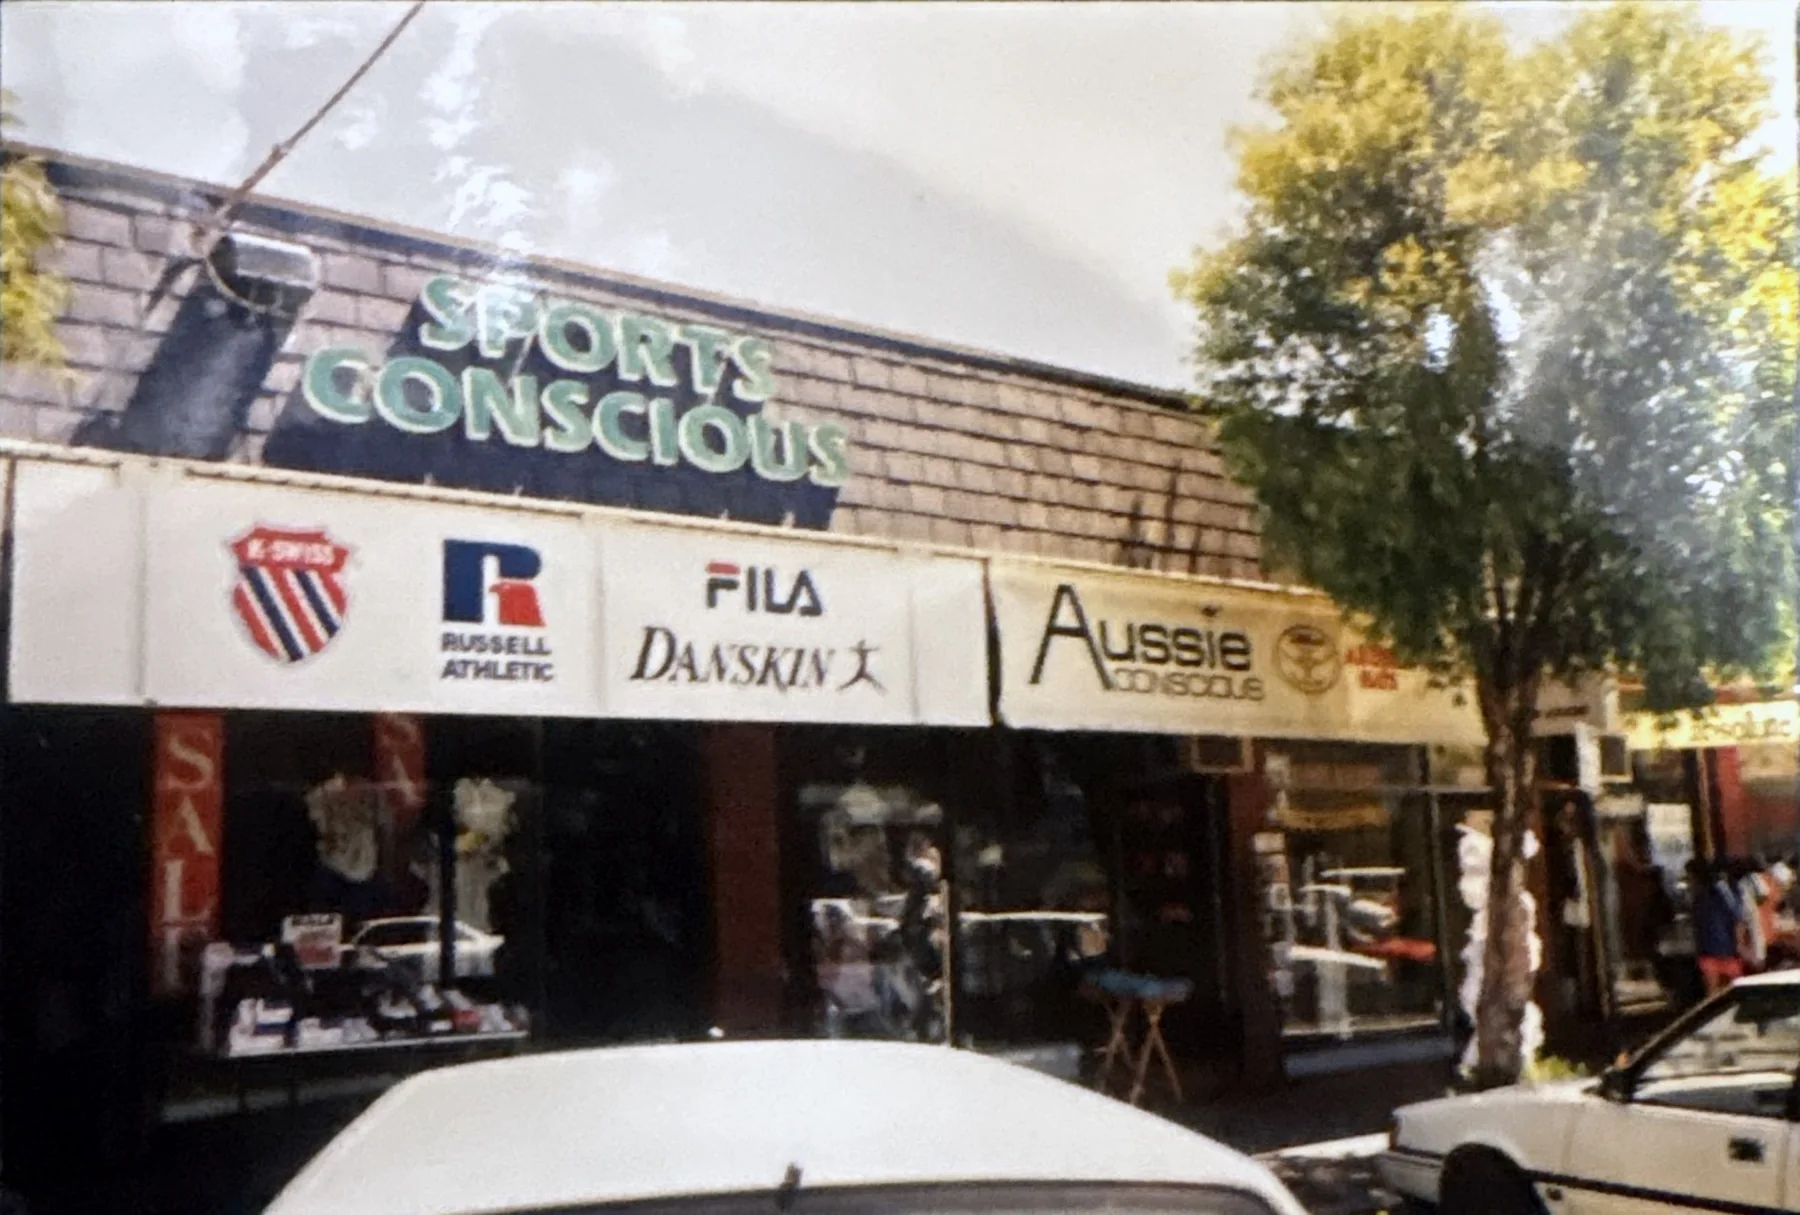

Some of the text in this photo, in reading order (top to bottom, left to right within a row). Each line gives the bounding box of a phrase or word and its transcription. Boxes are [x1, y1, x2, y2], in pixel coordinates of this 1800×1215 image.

[420, 275, 776, 402] SPORTS
[302, 345, 849, 487] CONSCIOUS
[705, 561, 824, 616] FILA
[440, 660, 554, 681] ATHLETIC
[441, 632, 552, 655] RUSSELL
[630, 625, 836, 693] DANSKIN
[1027, 584, 1253, 692] Aussie
